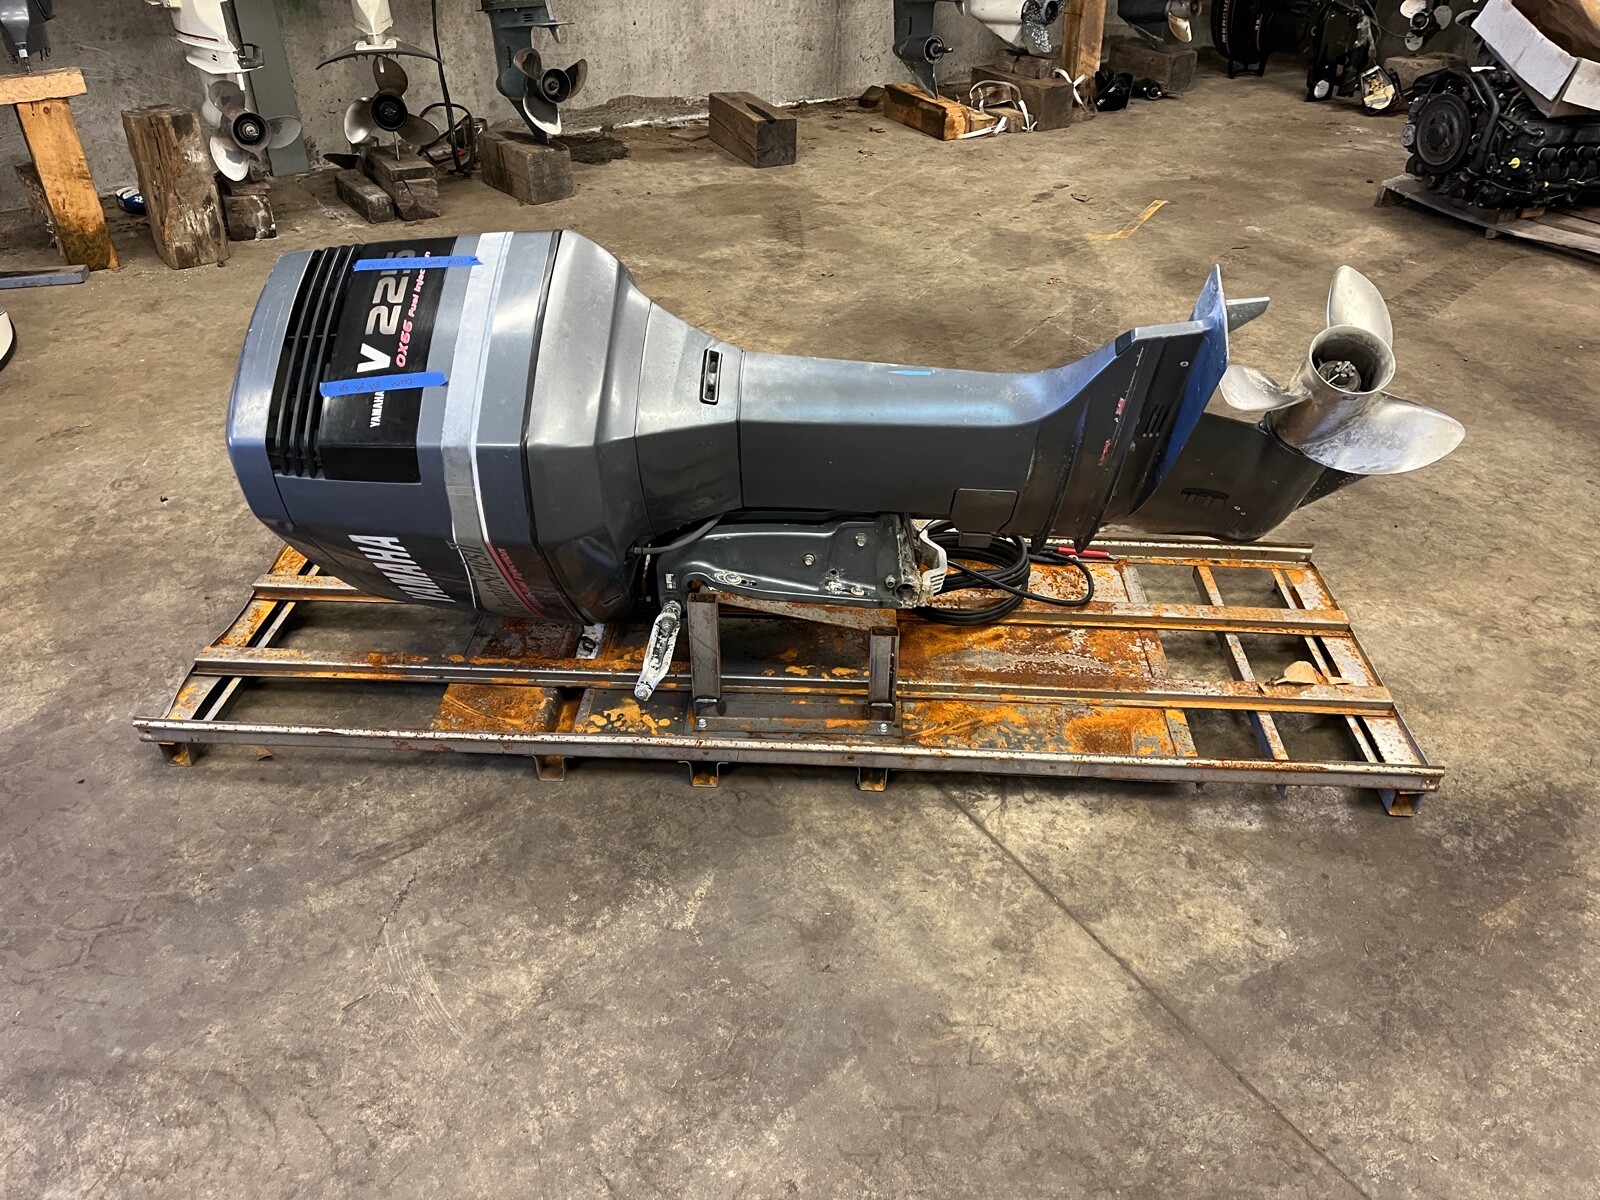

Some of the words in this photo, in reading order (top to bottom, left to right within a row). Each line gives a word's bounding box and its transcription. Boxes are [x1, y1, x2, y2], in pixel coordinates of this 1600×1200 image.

[395, 319, 413, 368] OX66
[408, 293, 420, 318] Fuel
[357, 343, 391, 373] V
[369, 391, 385, 428] YAMAHA
[348, 534, 456, 603] YAMAHA
